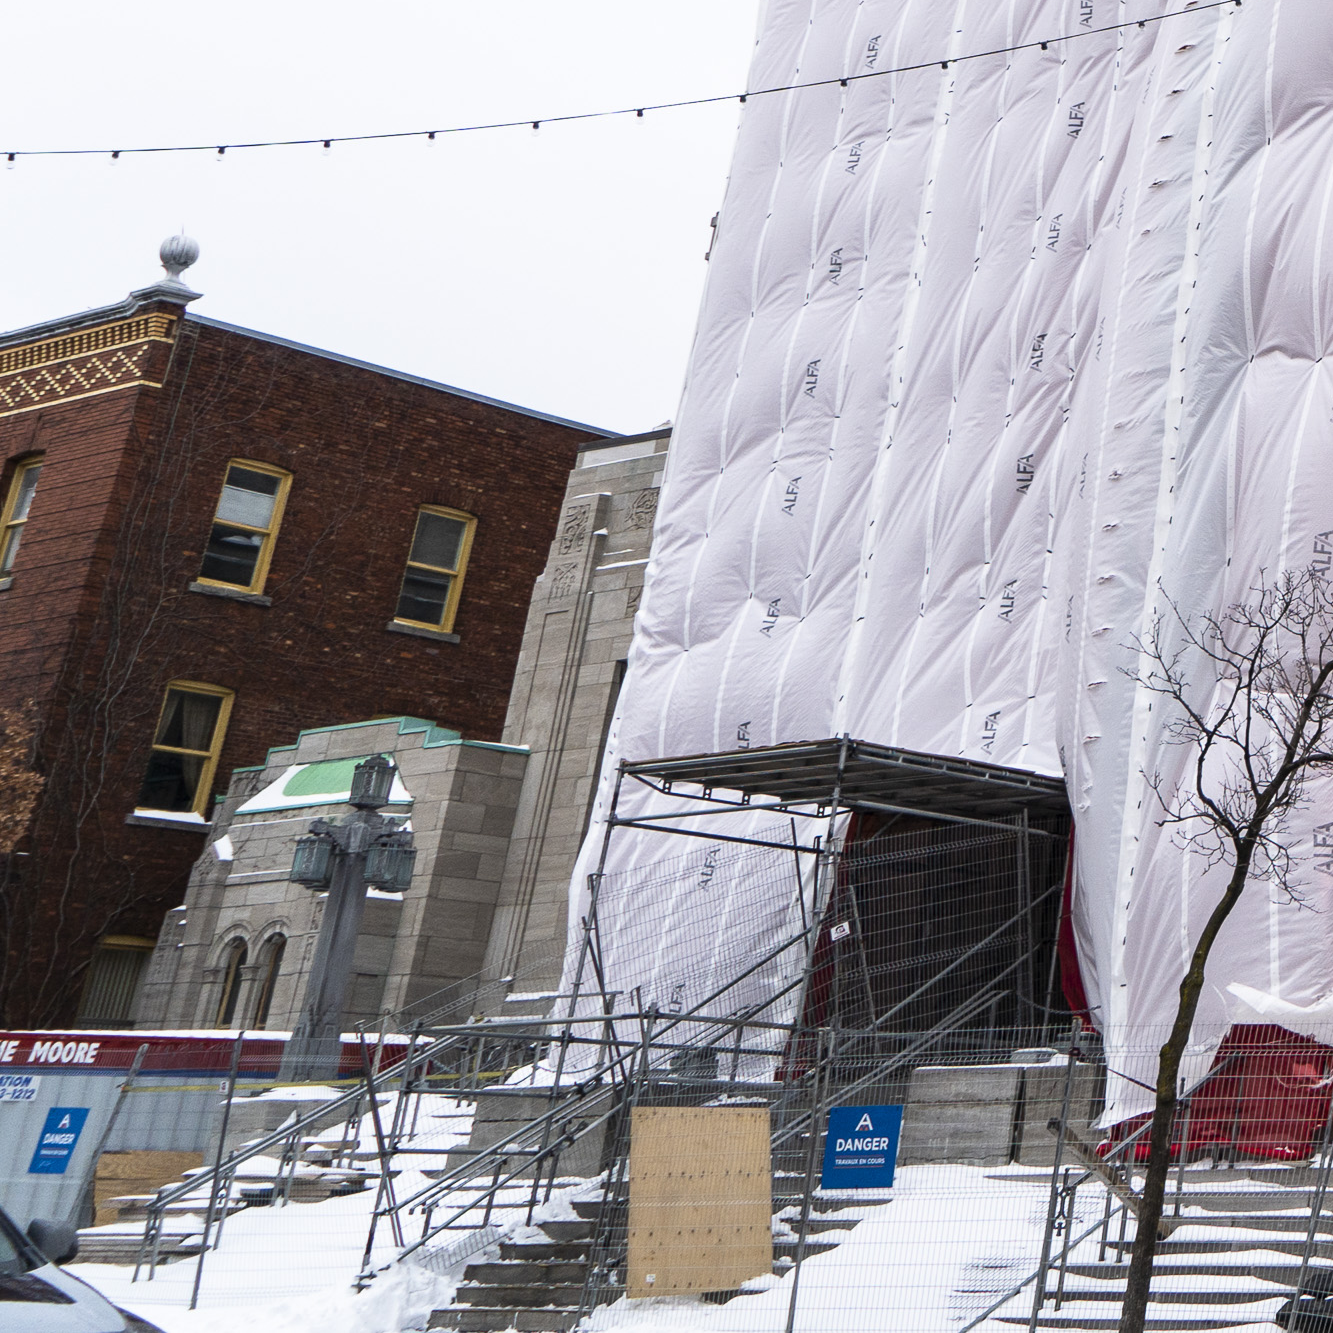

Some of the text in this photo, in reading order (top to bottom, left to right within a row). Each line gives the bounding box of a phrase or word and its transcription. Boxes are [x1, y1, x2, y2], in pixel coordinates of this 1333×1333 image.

[865, 34, 882, 69] ALFA
[1068, 101, 1085, 139] ALFA
[845, 140, 865, 175] ALFA
[1046, 212, 1064, 253] ALFA
[829, 247, 843, 286] ALFA
[1030, 331, 1048, 372] ALFA
[804, 358, 821, 398] ALFA
[1015, 452, 1034, 495] ALFA
[781, 476, 802, 517] ALFA
[759, 597, 781, 638] ALFA
[997, 578, 1017, 624] ALFA
[737, 720, 752, 750] LFA
[981, 710, 1001, 755] ALFA
[698, 847, 721, 892] ALFA
[670, 983, 686, 1015] LFA
[27, 1041, 102, 1064] MOORE
[42, 1133, 76, 1145] DANGER
[835, 1137, 889, 1152] DANGER
